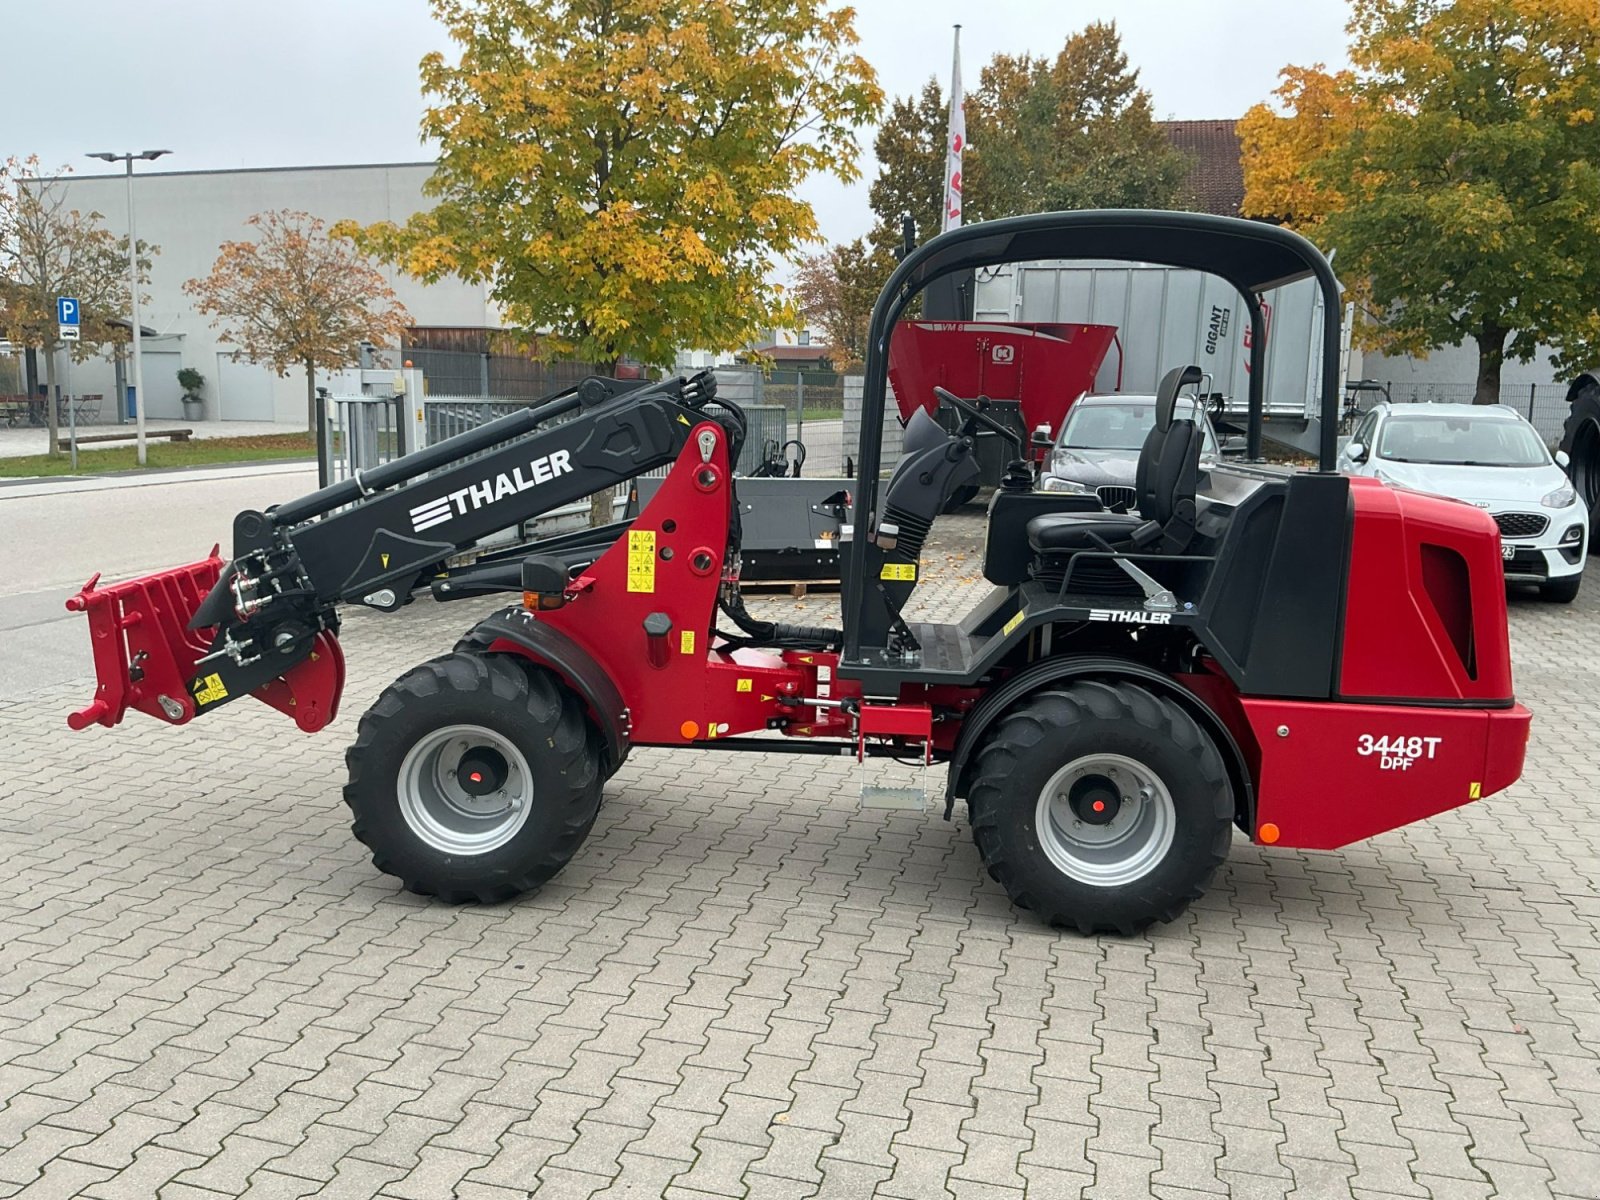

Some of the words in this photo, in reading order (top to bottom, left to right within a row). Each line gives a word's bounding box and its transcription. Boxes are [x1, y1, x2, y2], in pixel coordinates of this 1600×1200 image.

[62, 300, 75, 322] P
[942, 323, 957, 332] VM
[957, 323, 964, 332] 8
[1205, 304, 1223, 355] GIGANT
[447, 449, 574, 516] THALER
[1109, 610, 1172, 625] THALER
[1357, 733, 1443, 759] 3448T
[1380, 756, 1415, 771] DPF
